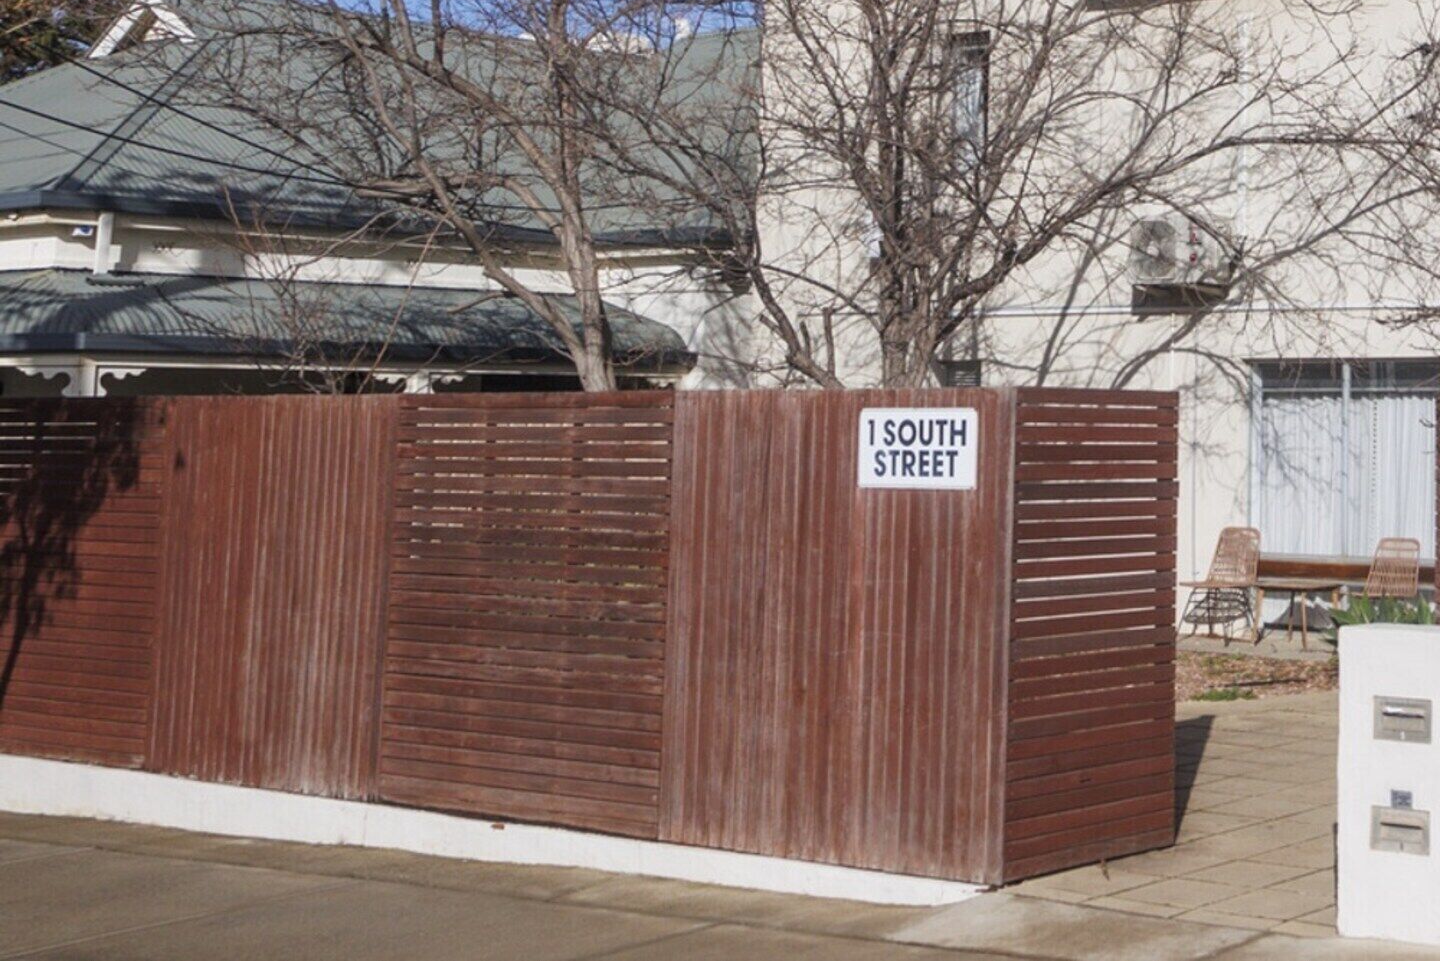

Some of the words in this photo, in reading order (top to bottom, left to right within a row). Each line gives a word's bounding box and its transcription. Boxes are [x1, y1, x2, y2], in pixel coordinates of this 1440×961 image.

[867, 419, 875, 446] 1
[883, 419, 966, 446] SOUTH
[873, 449, 959, 477] STREET
